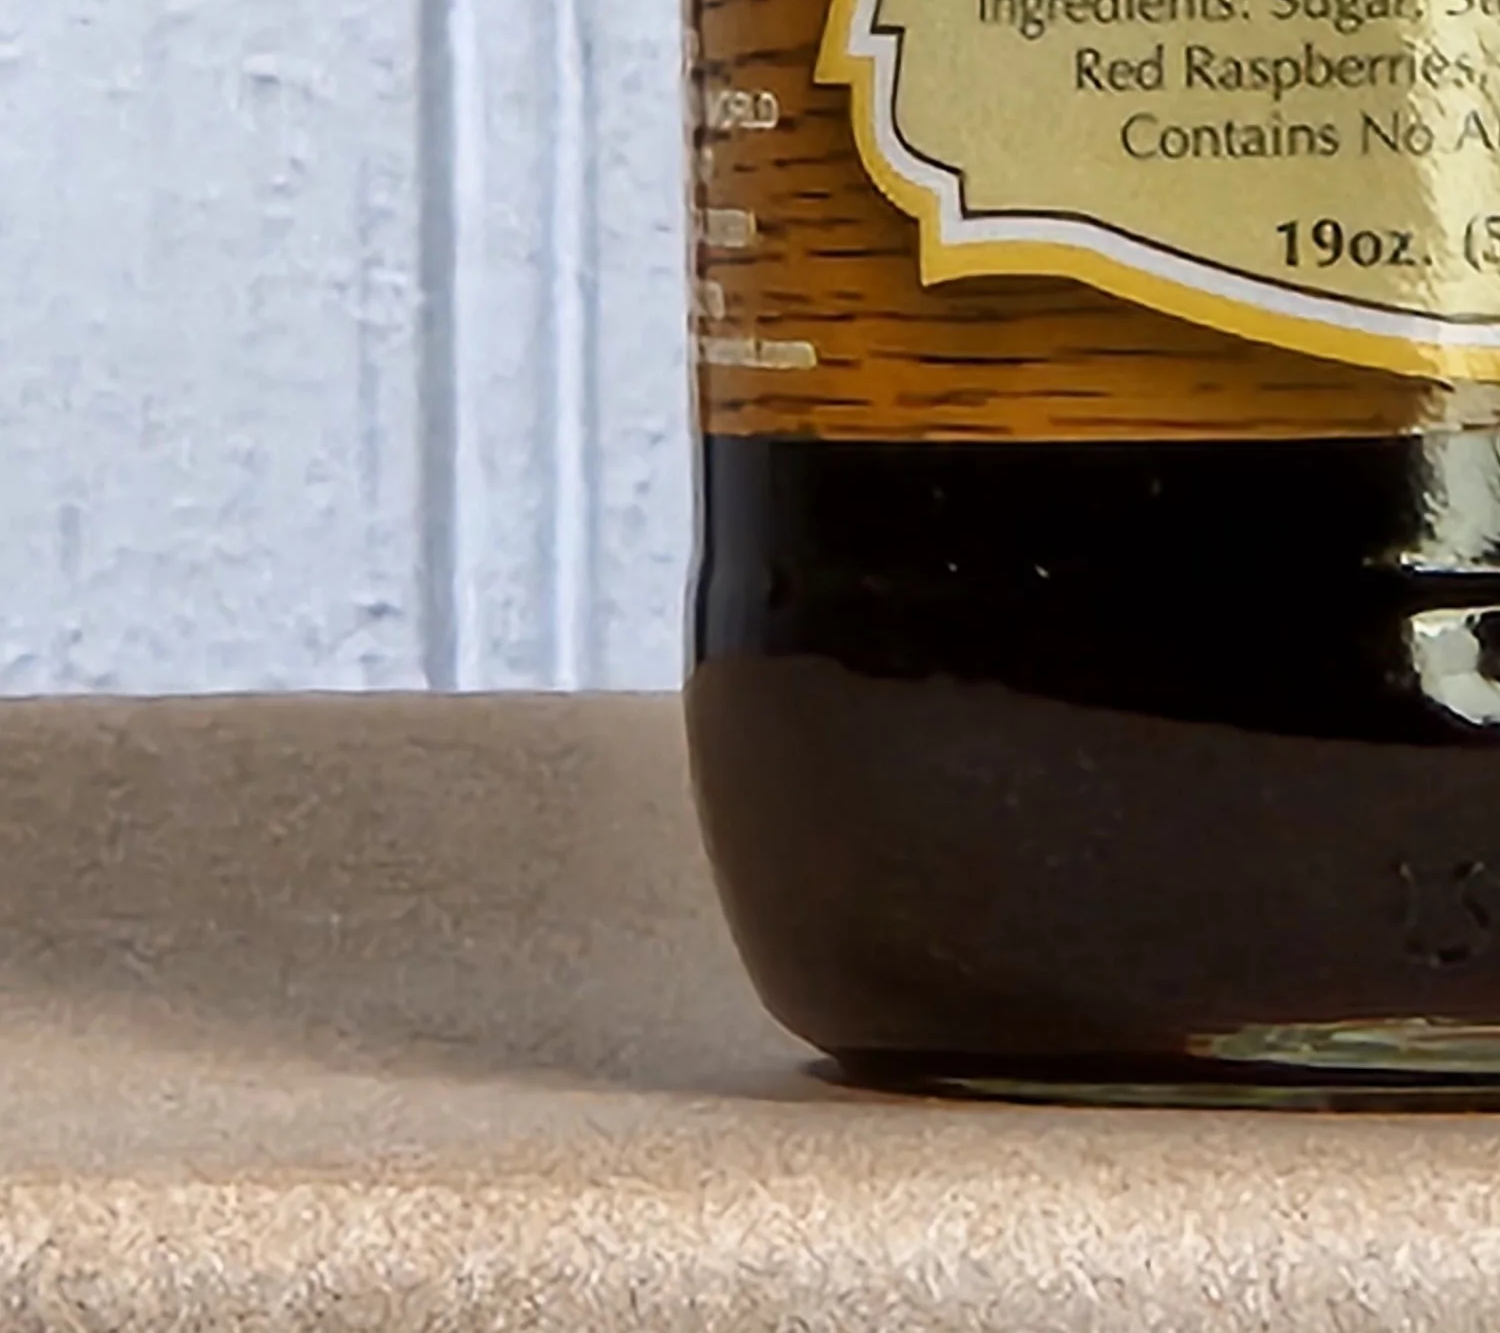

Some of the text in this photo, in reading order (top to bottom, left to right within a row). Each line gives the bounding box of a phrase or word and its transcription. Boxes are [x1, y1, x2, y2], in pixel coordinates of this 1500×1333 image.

[1075, 44, 1164, 91] Red
[1185, 42, 1490, 101] Raspberries,
[1121, 109, 1340, 161] Contains
[1361, 109, 1434, 158] No
[1276, 218, 1433, 269] 19oz.
